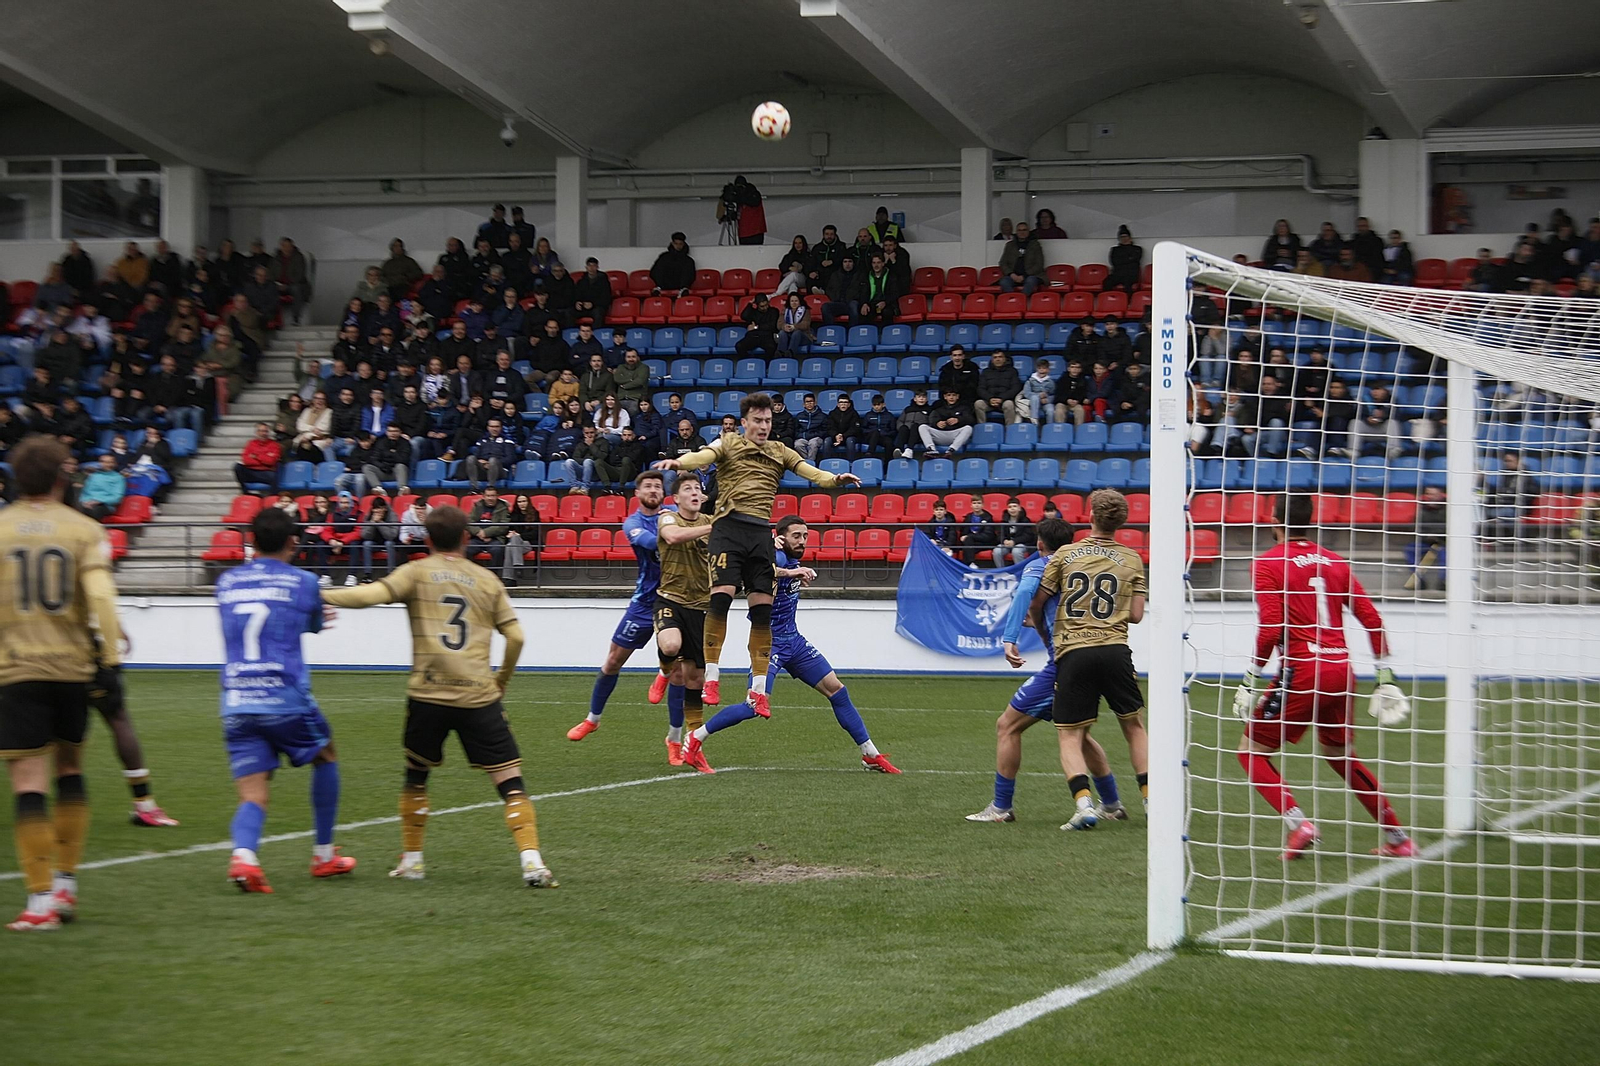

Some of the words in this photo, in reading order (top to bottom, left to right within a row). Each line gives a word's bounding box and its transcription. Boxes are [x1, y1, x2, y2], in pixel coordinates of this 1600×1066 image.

[1161, 329, 1174, 388] MONDO
[710, 553, 728, 571] 24
[1063, 545, 1125, 566] CARBONELL
[9, 546, 74, 616] 10
[1065, 571, 1118, 620] 28
[1308, 577, 1331, 628] 1
[232, 602, 270, 661] 7
[438, 594, 470, 652] 3
[657, 607, 673, 620] 15
[957, 634, 993, 650] DESDE
